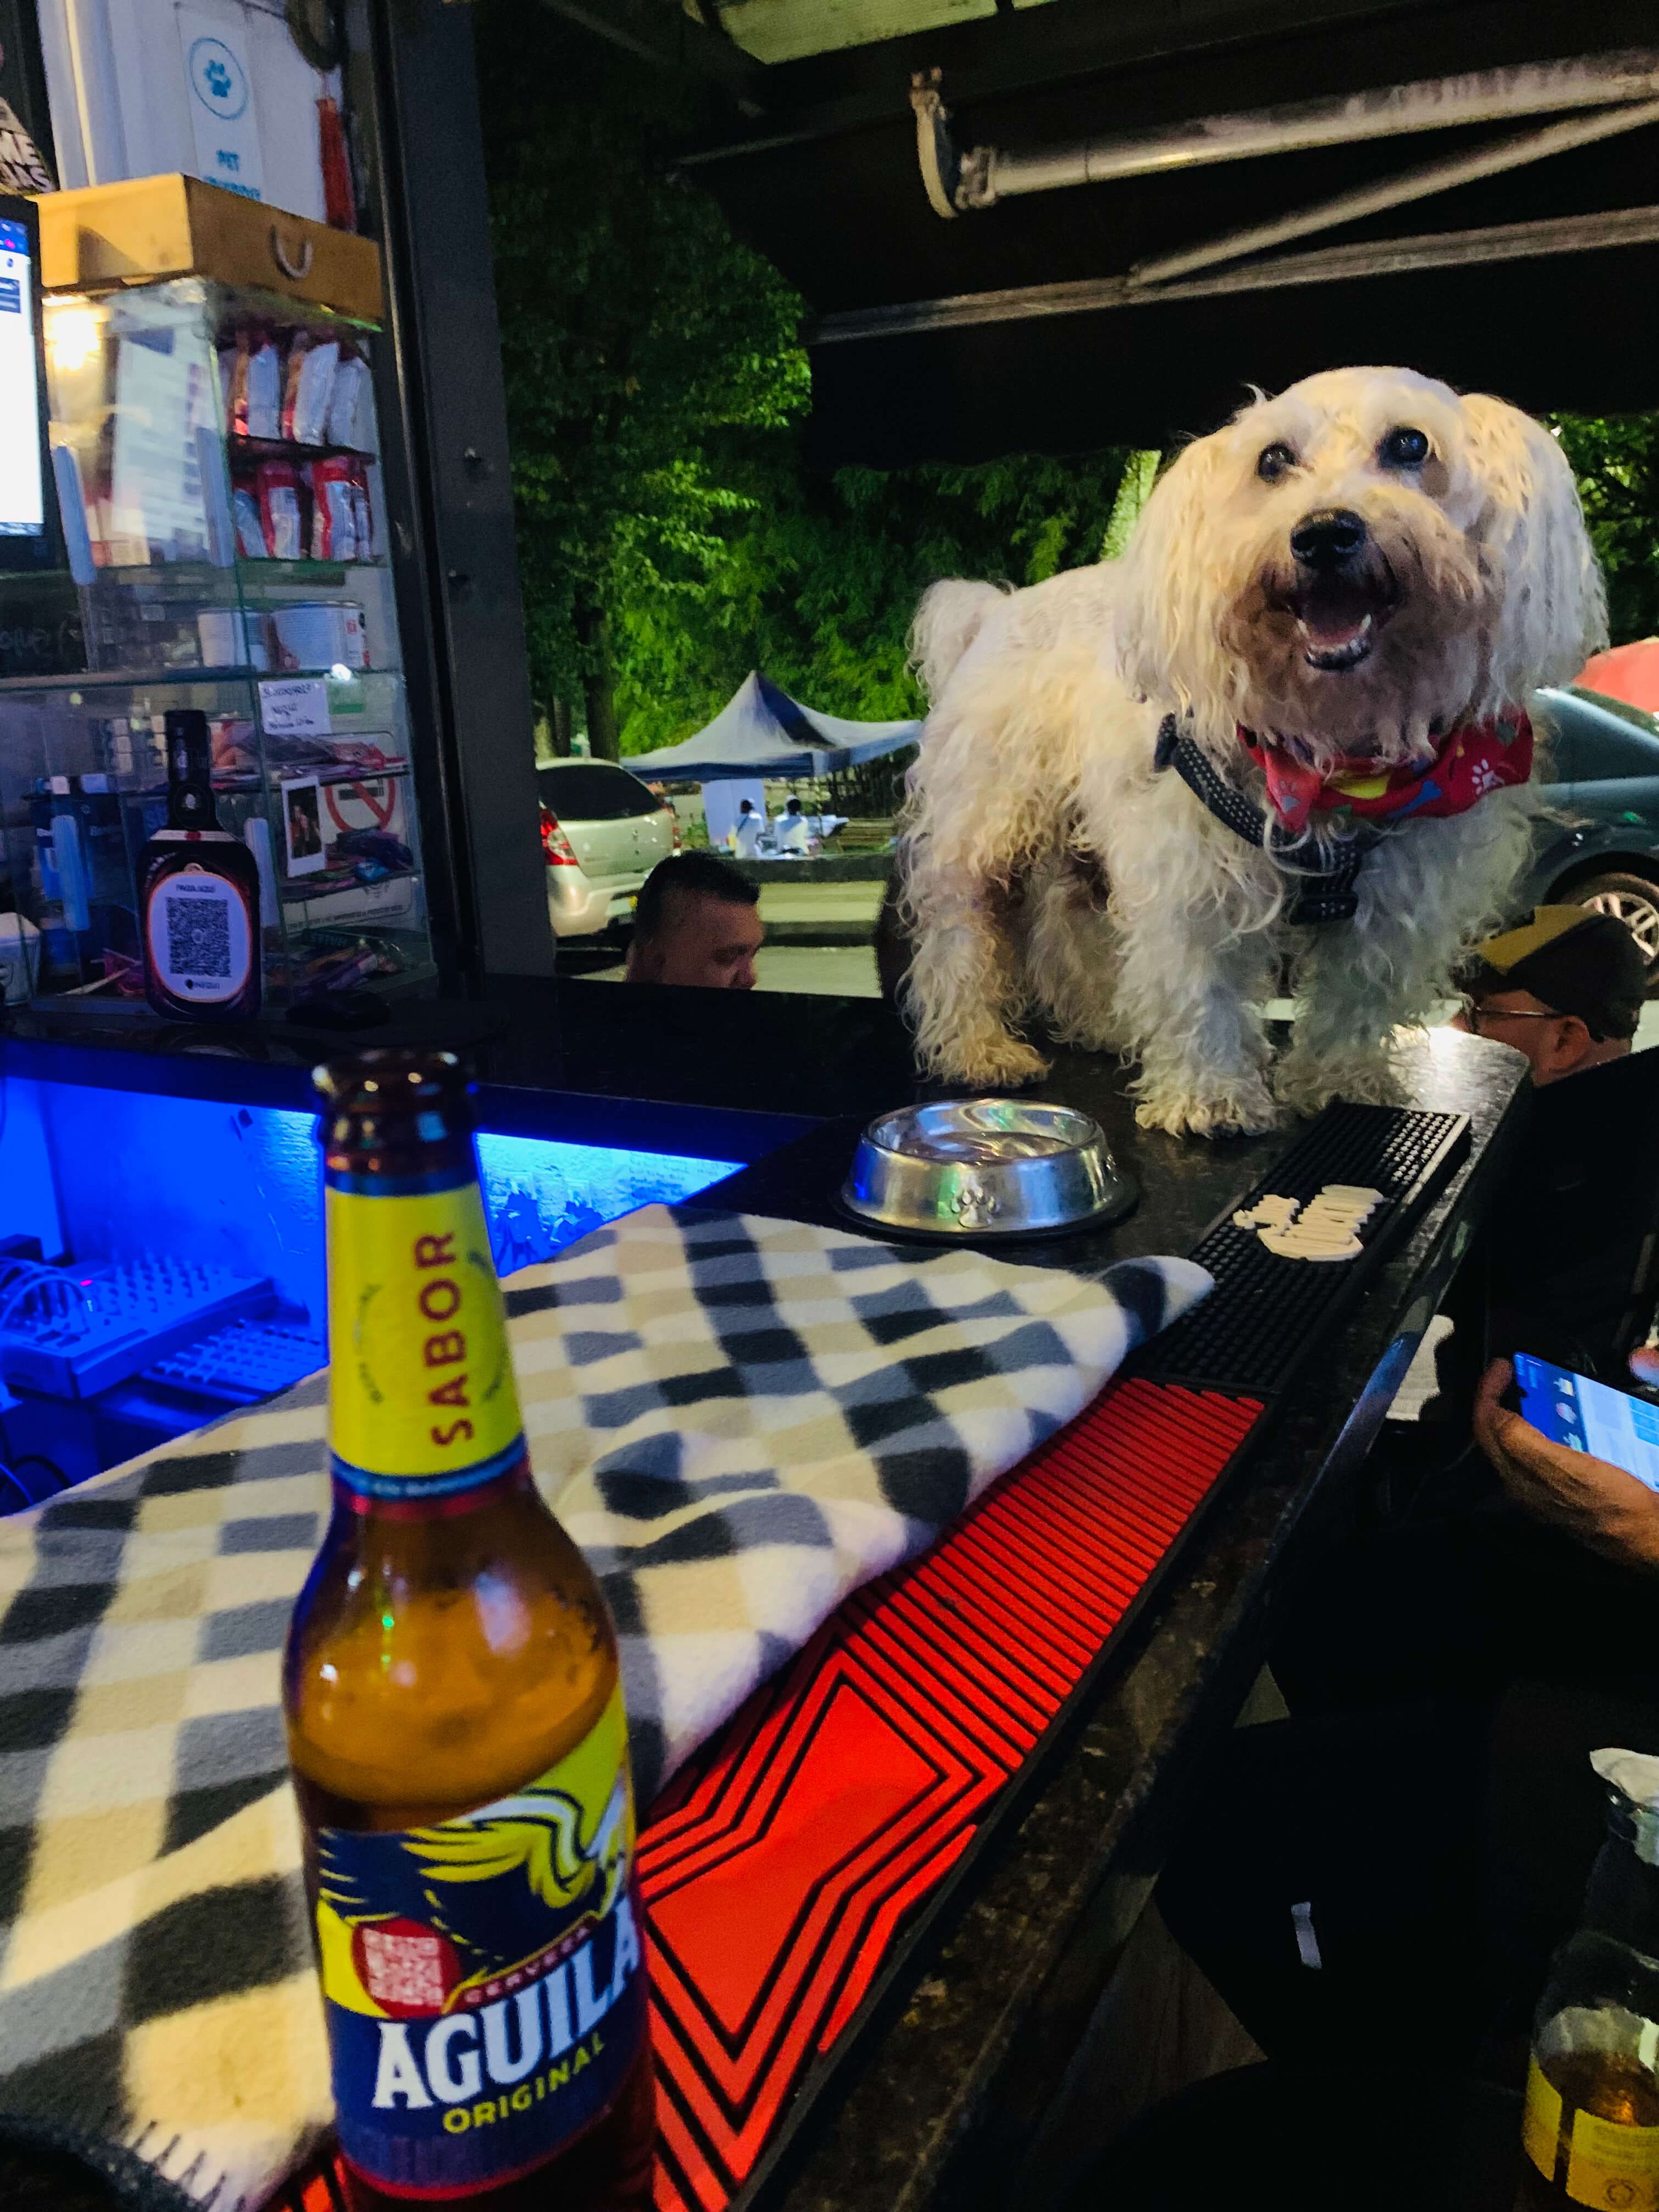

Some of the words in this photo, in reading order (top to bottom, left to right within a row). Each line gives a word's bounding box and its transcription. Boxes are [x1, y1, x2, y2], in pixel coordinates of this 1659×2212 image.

[414, 1230, 474, 1447] SABOR
[372, 1894, 641, 2110] AGUILA
[442, 2033, 605, 2135] ORIGINAL
